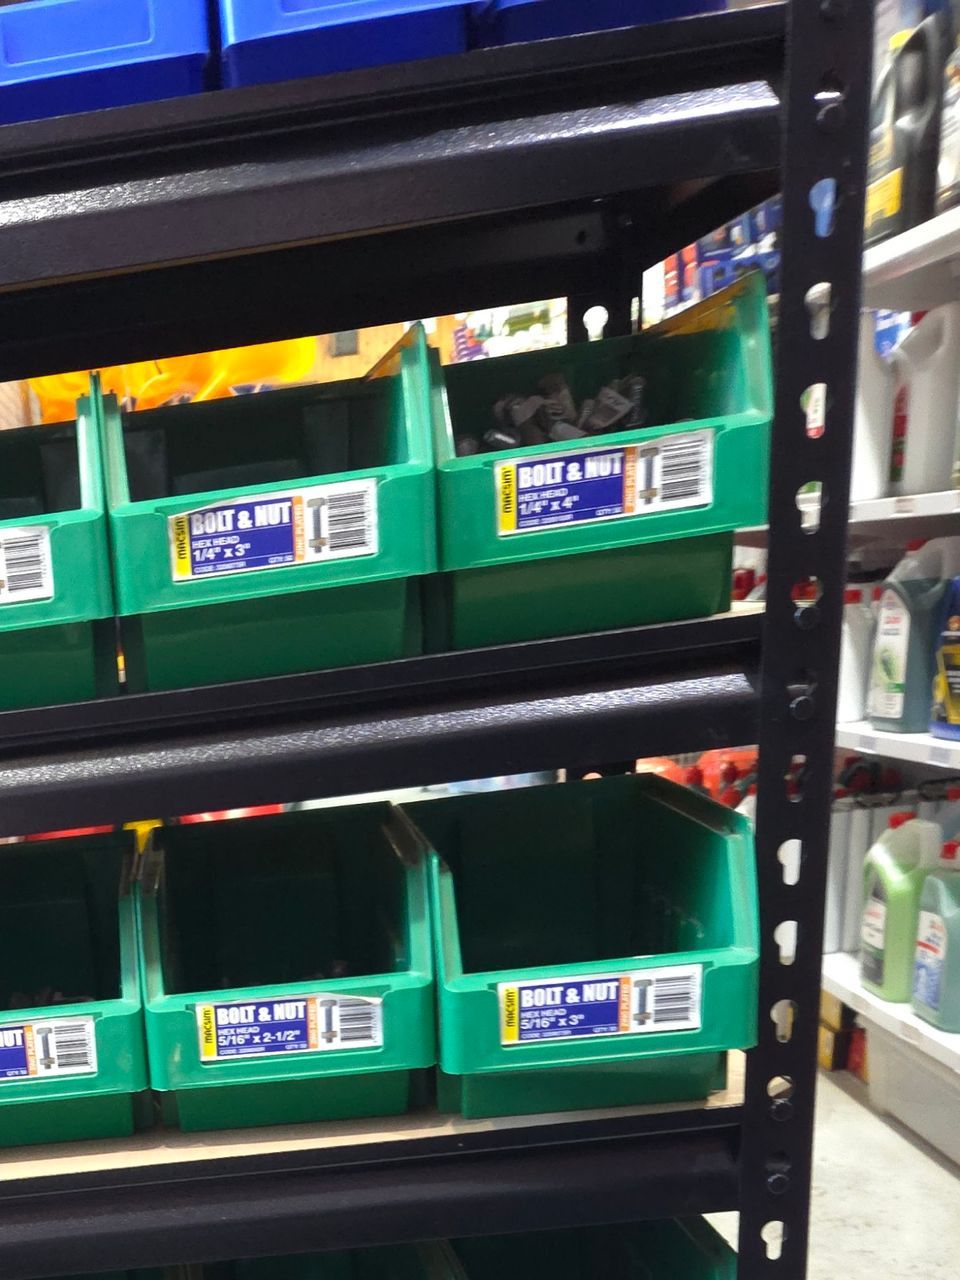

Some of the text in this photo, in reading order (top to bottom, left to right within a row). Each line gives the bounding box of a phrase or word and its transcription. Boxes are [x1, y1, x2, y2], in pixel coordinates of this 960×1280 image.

[518, 453, 623, 488] BOLT & NUT
[550, 501, 561, 511] x
[191, 501, 292, 535] BOLT & NUT
[224, 548, 233, 558] x
[521, 979, 619, 1007] BOLT & NUT
[217, 1001, 307, 1025] BOLT & NUT
[558, 1016, 567, 1025] x
[253, 1035, 261, 1043] x
